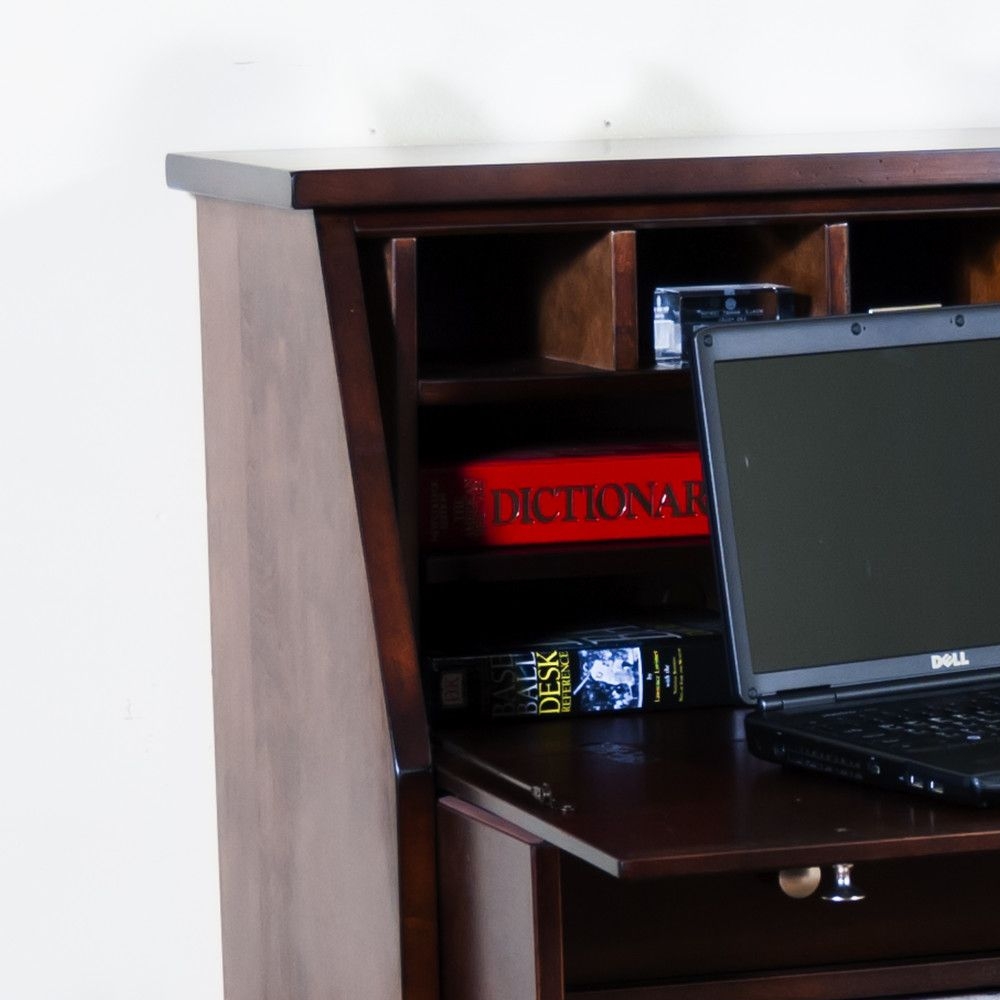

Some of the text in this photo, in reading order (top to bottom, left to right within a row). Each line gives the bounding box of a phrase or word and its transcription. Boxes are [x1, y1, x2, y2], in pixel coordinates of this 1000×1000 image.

[515, 651, 538, 714] BALL
[536, 650, 561, 714] DESK
[559, 650, 572, 713] REFERENCE
[930, 651, 970, 669] DELL
